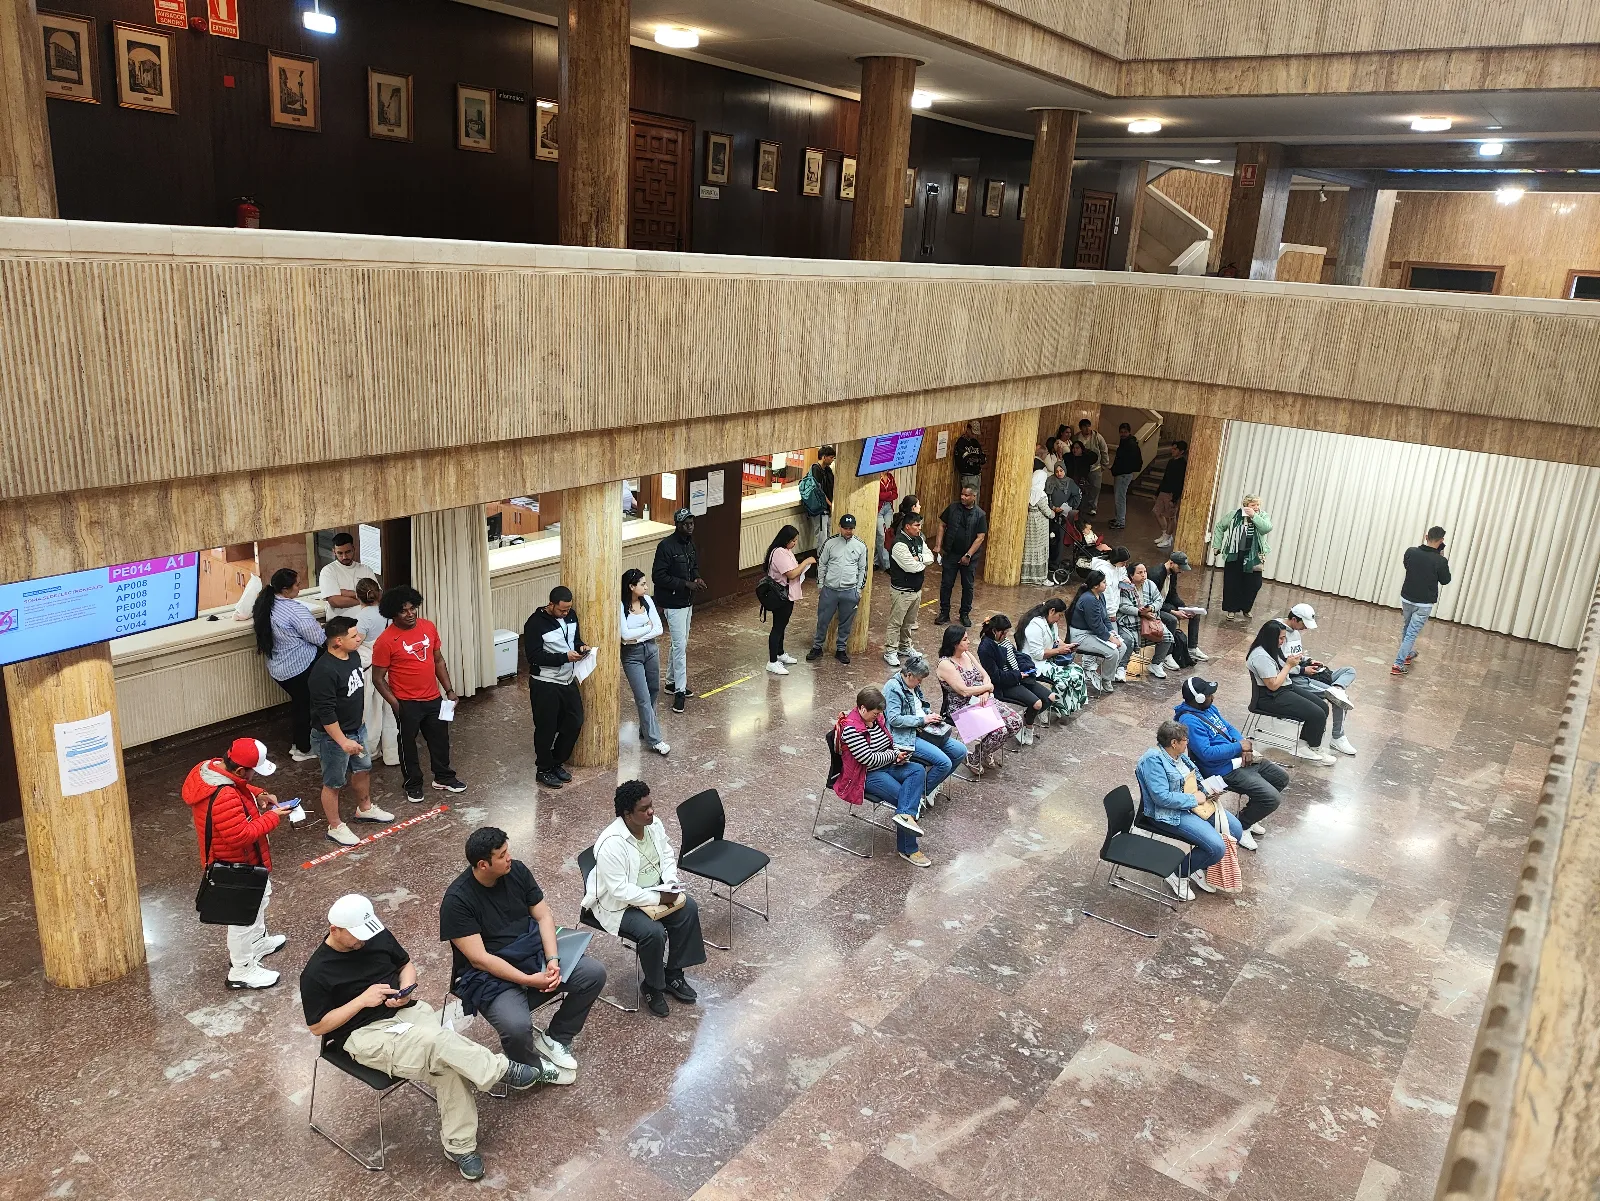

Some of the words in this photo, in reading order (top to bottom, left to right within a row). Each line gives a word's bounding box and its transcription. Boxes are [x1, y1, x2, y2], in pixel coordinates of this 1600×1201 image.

[157, 11, 185, 20] AVISADOR
[160, 18, 184, 26] SONORO
[212, 24, 236, 35] EXTINTOR
[112, 562, 152, 578] PE014
[165, 554, 184, 569] A1
[116, 580, 147, 592] AP008
[174, 572, 181, 580] D
[116, 590, 147, 603] AP008
[174, 582, 181, 590] D
[116, 600, 146, 612] PE008
[173, 592, 181, 600] D
[116, 610, 146, 622] CV044
[167, 602, 179, 611] A1
[116, 620, 146, 632] CV044
[167, 612, 179, 620] A1
[311, 838, 371, 865] ESPEE
[373, 828, 393, 840] SU
[393, 808, 442, 830] TURNO
